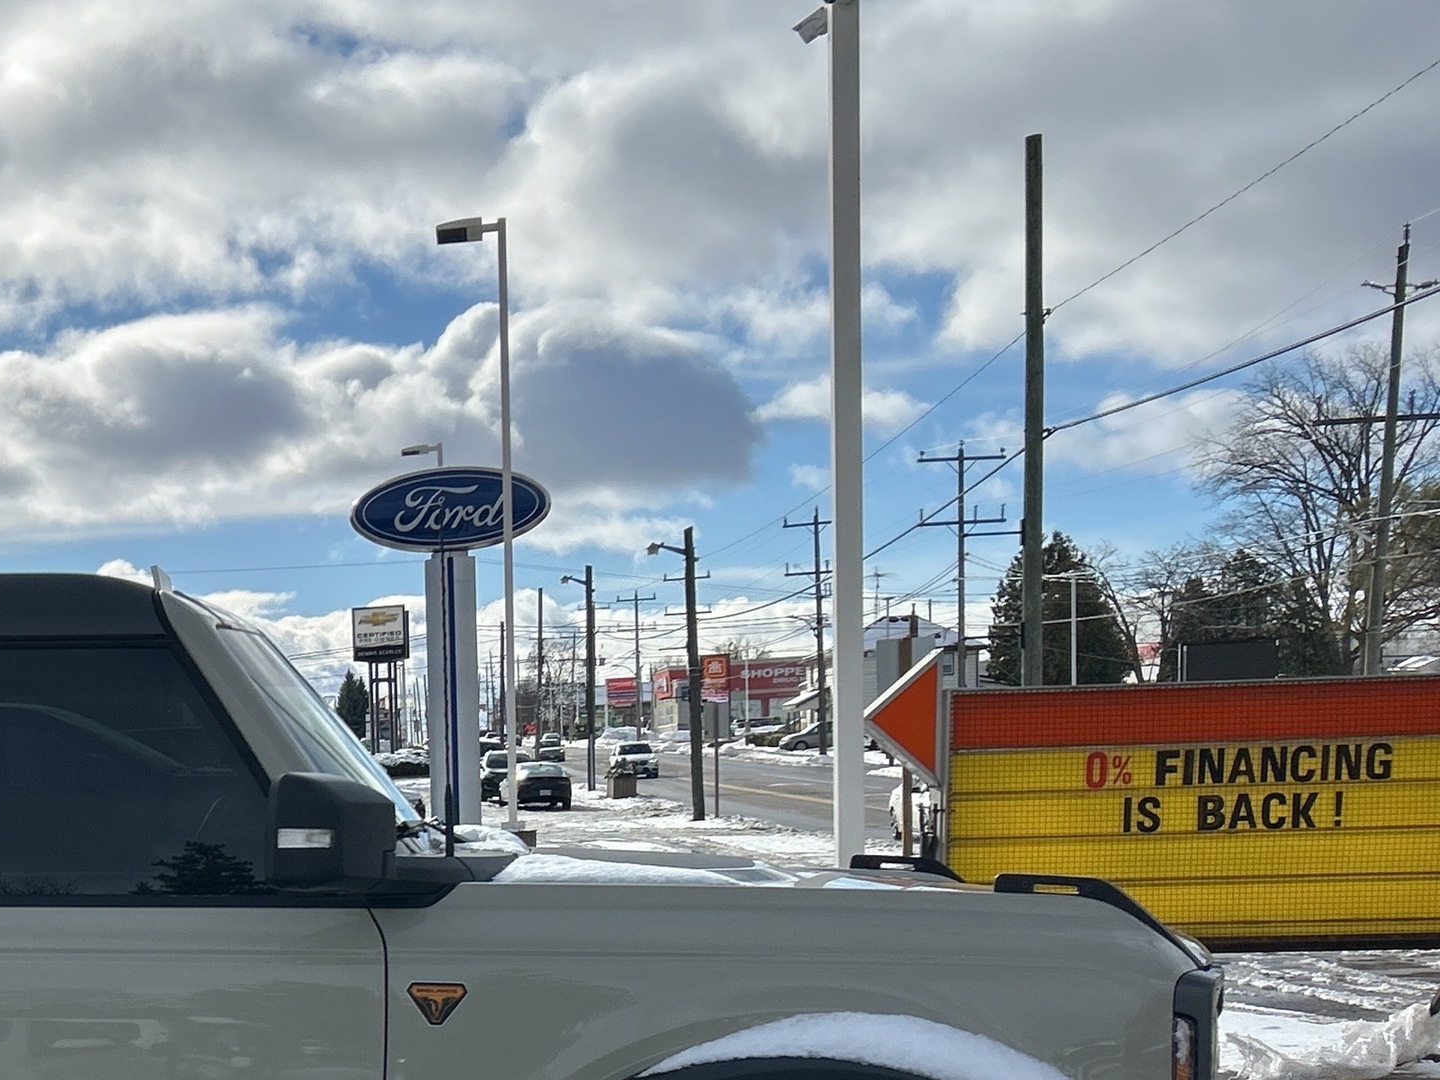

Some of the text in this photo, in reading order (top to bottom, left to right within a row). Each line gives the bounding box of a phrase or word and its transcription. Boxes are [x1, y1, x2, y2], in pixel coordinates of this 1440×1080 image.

[394, 485, 506, 532] Ford
[740, 667, 808, 678] SHOPPE
[1085, 743, 1393, 789] 0% FINANCING
[1122, 796, 1161, 833] IS
